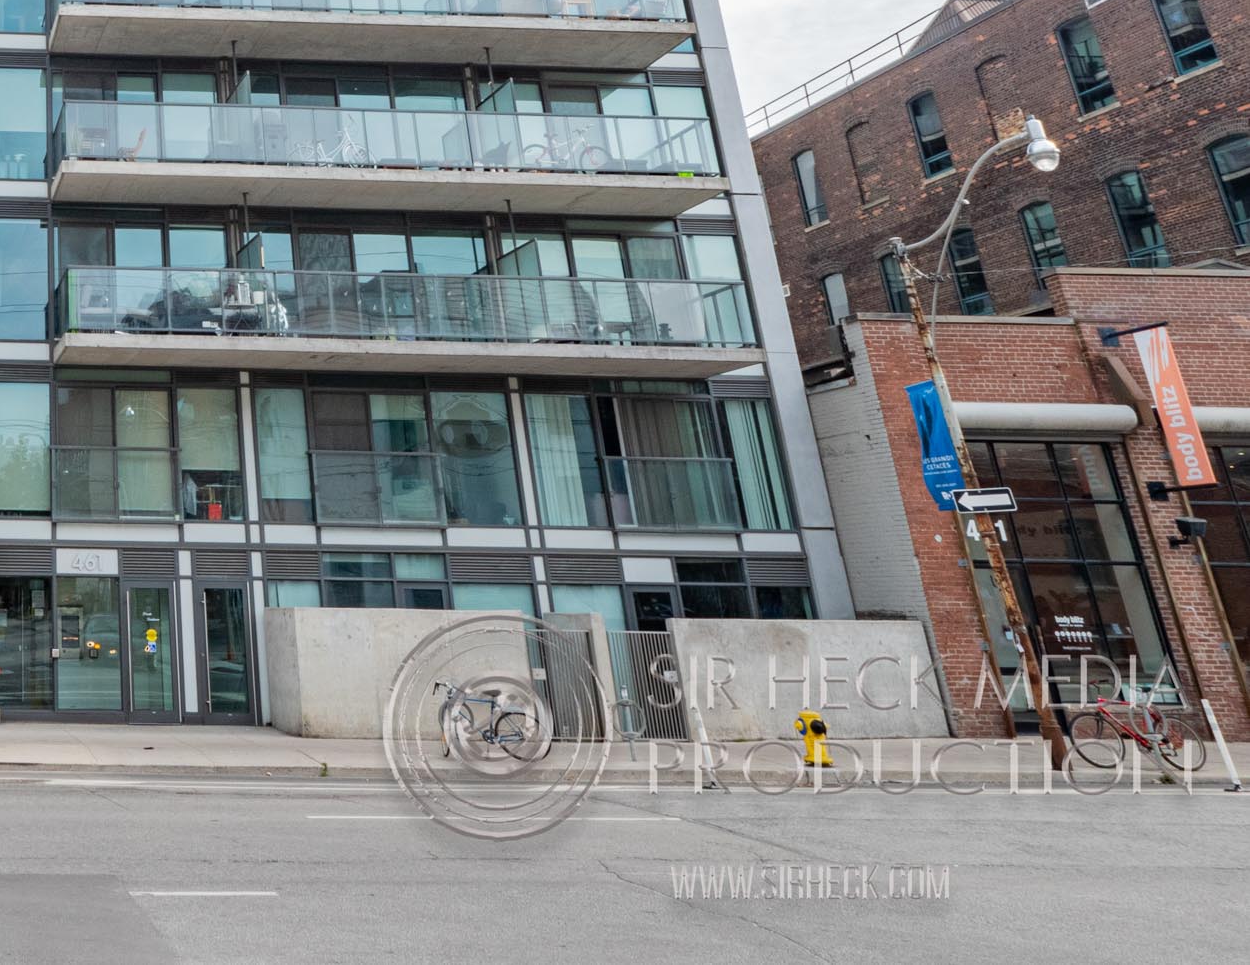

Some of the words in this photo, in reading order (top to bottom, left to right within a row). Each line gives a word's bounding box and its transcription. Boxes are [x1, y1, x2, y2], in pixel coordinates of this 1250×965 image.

[1162, 385, 1187, 428] blitz
[1175, 432, 1203, 481] body
[966, 519, 1008, 542] 41
[70, 554, 102, 572] 461
